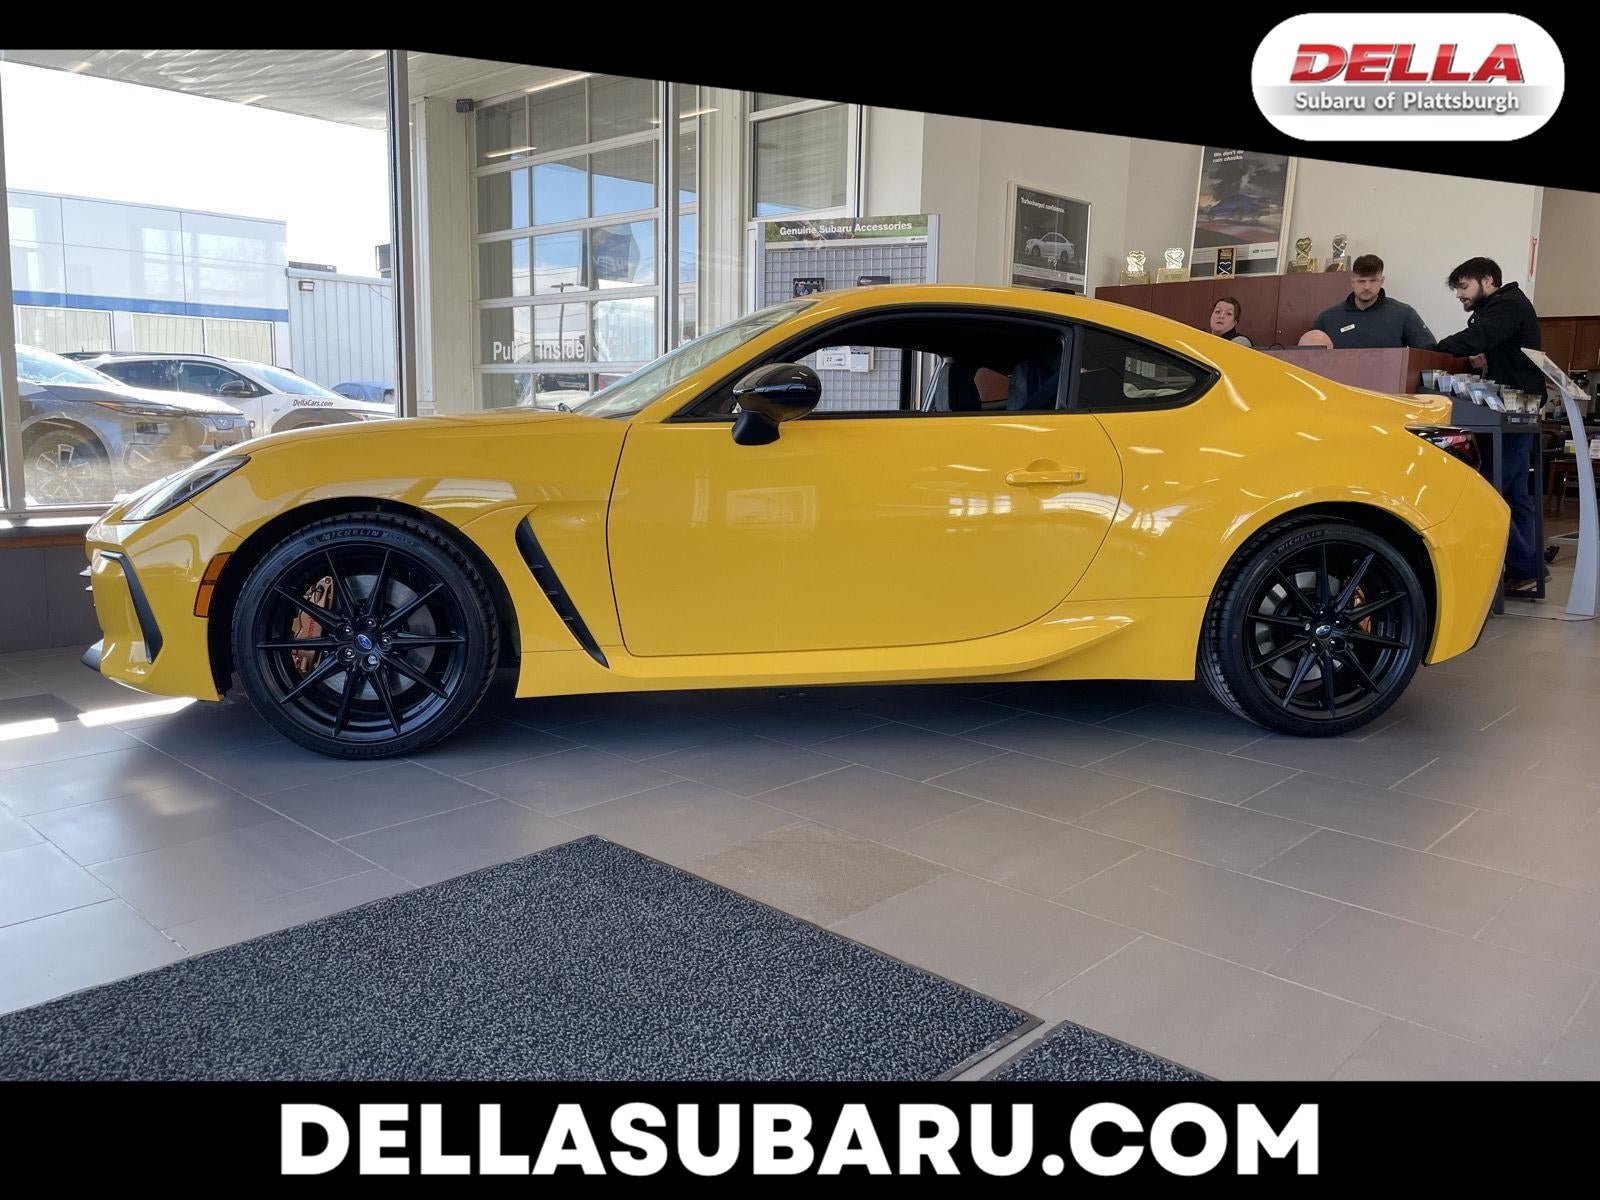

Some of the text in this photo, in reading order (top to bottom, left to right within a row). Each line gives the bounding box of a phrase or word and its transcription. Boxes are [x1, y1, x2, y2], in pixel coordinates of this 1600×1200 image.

[779, 221, 913, 236] Genuine Subaru Accessories
[321, 528, 380, 541] MICHELIN
[1278, 530, 1322, 551] MICHELIN
